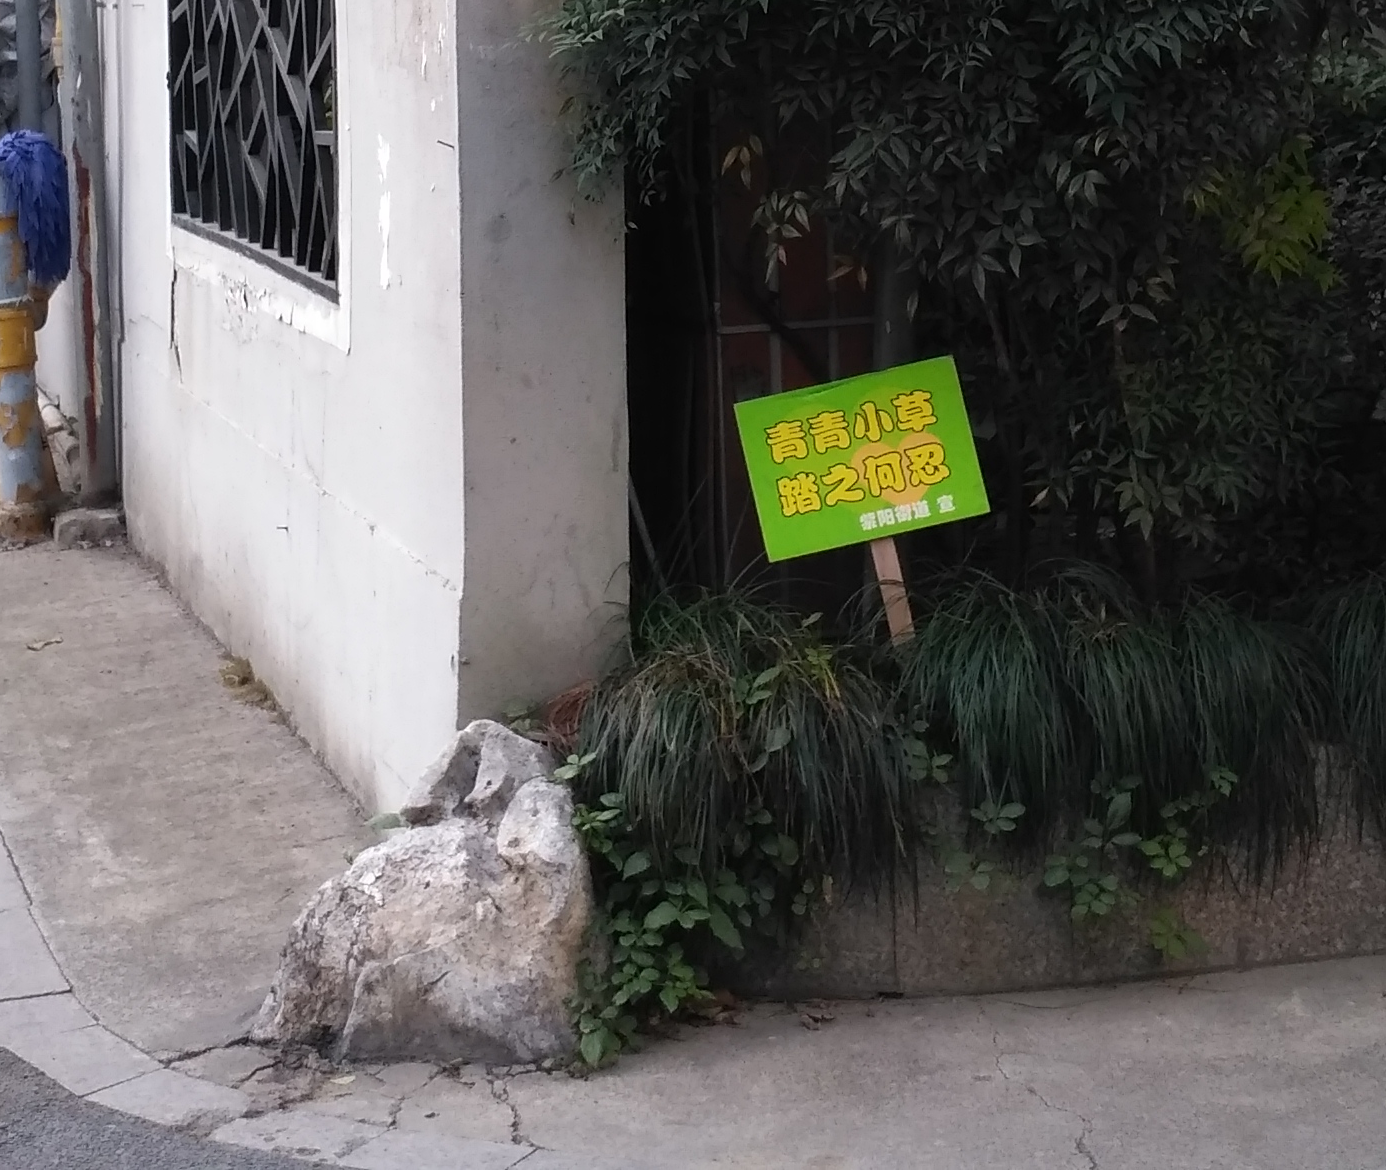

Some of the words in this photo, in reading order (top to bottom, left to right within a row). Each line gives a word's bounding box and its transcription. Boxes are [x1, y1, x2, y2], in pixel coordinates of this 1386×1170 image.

[765, 390, 938, 464] 青青小草
[777, 442, 951, 517] 踏之何忍
